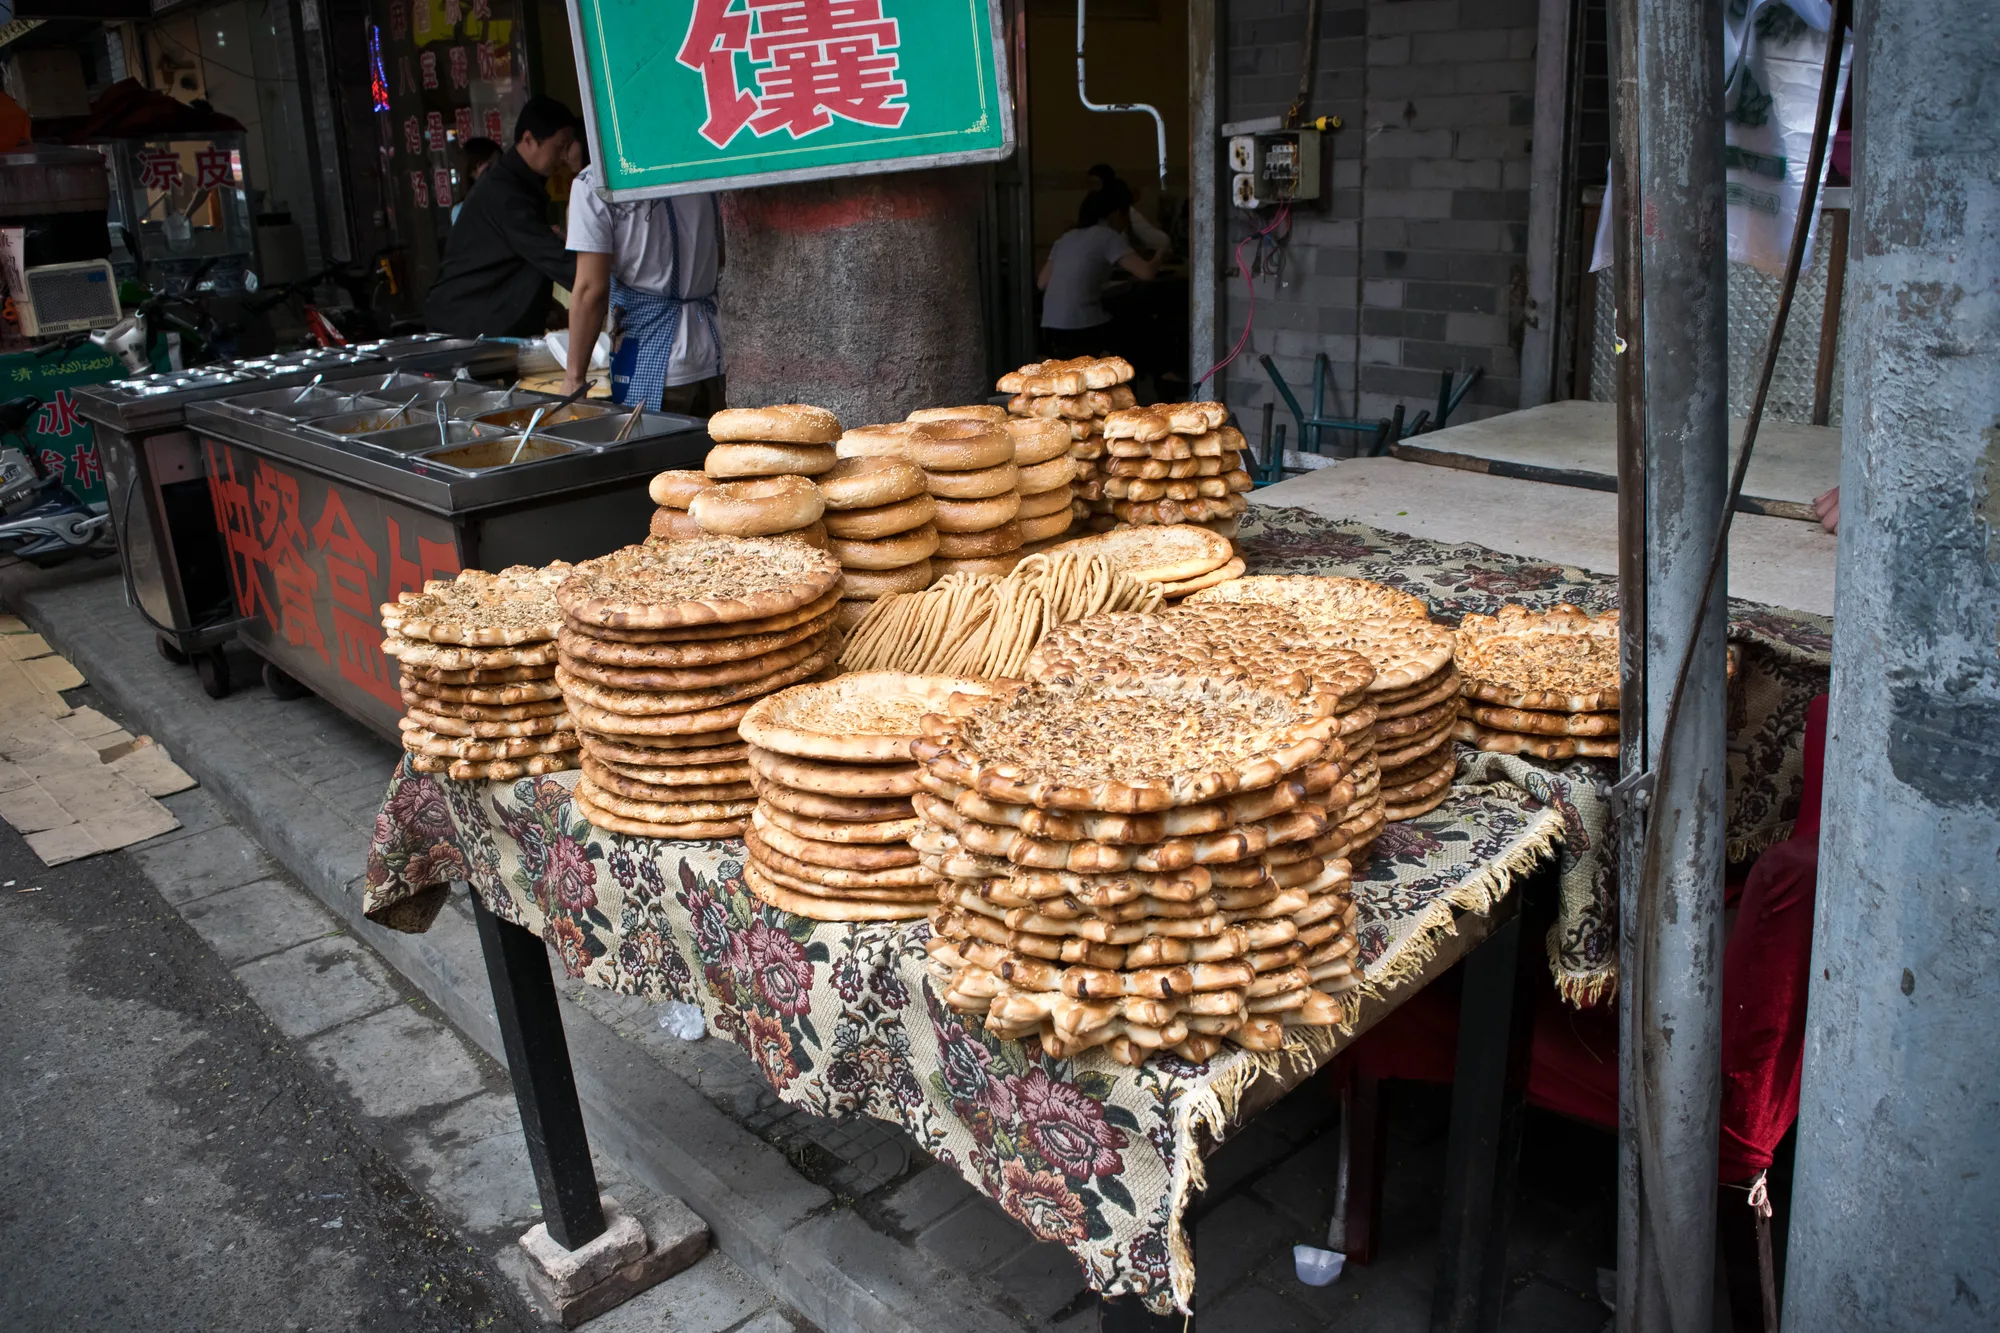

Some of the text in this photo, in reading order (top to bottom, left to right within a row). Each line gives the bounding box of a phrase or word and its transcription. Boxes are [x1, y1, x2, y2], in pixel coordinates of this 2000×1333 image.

[136, 146, 237, 190] 凉皮
[411, 168, 452, 208] 汤圆
[36, 390, 87, 437] 冰
